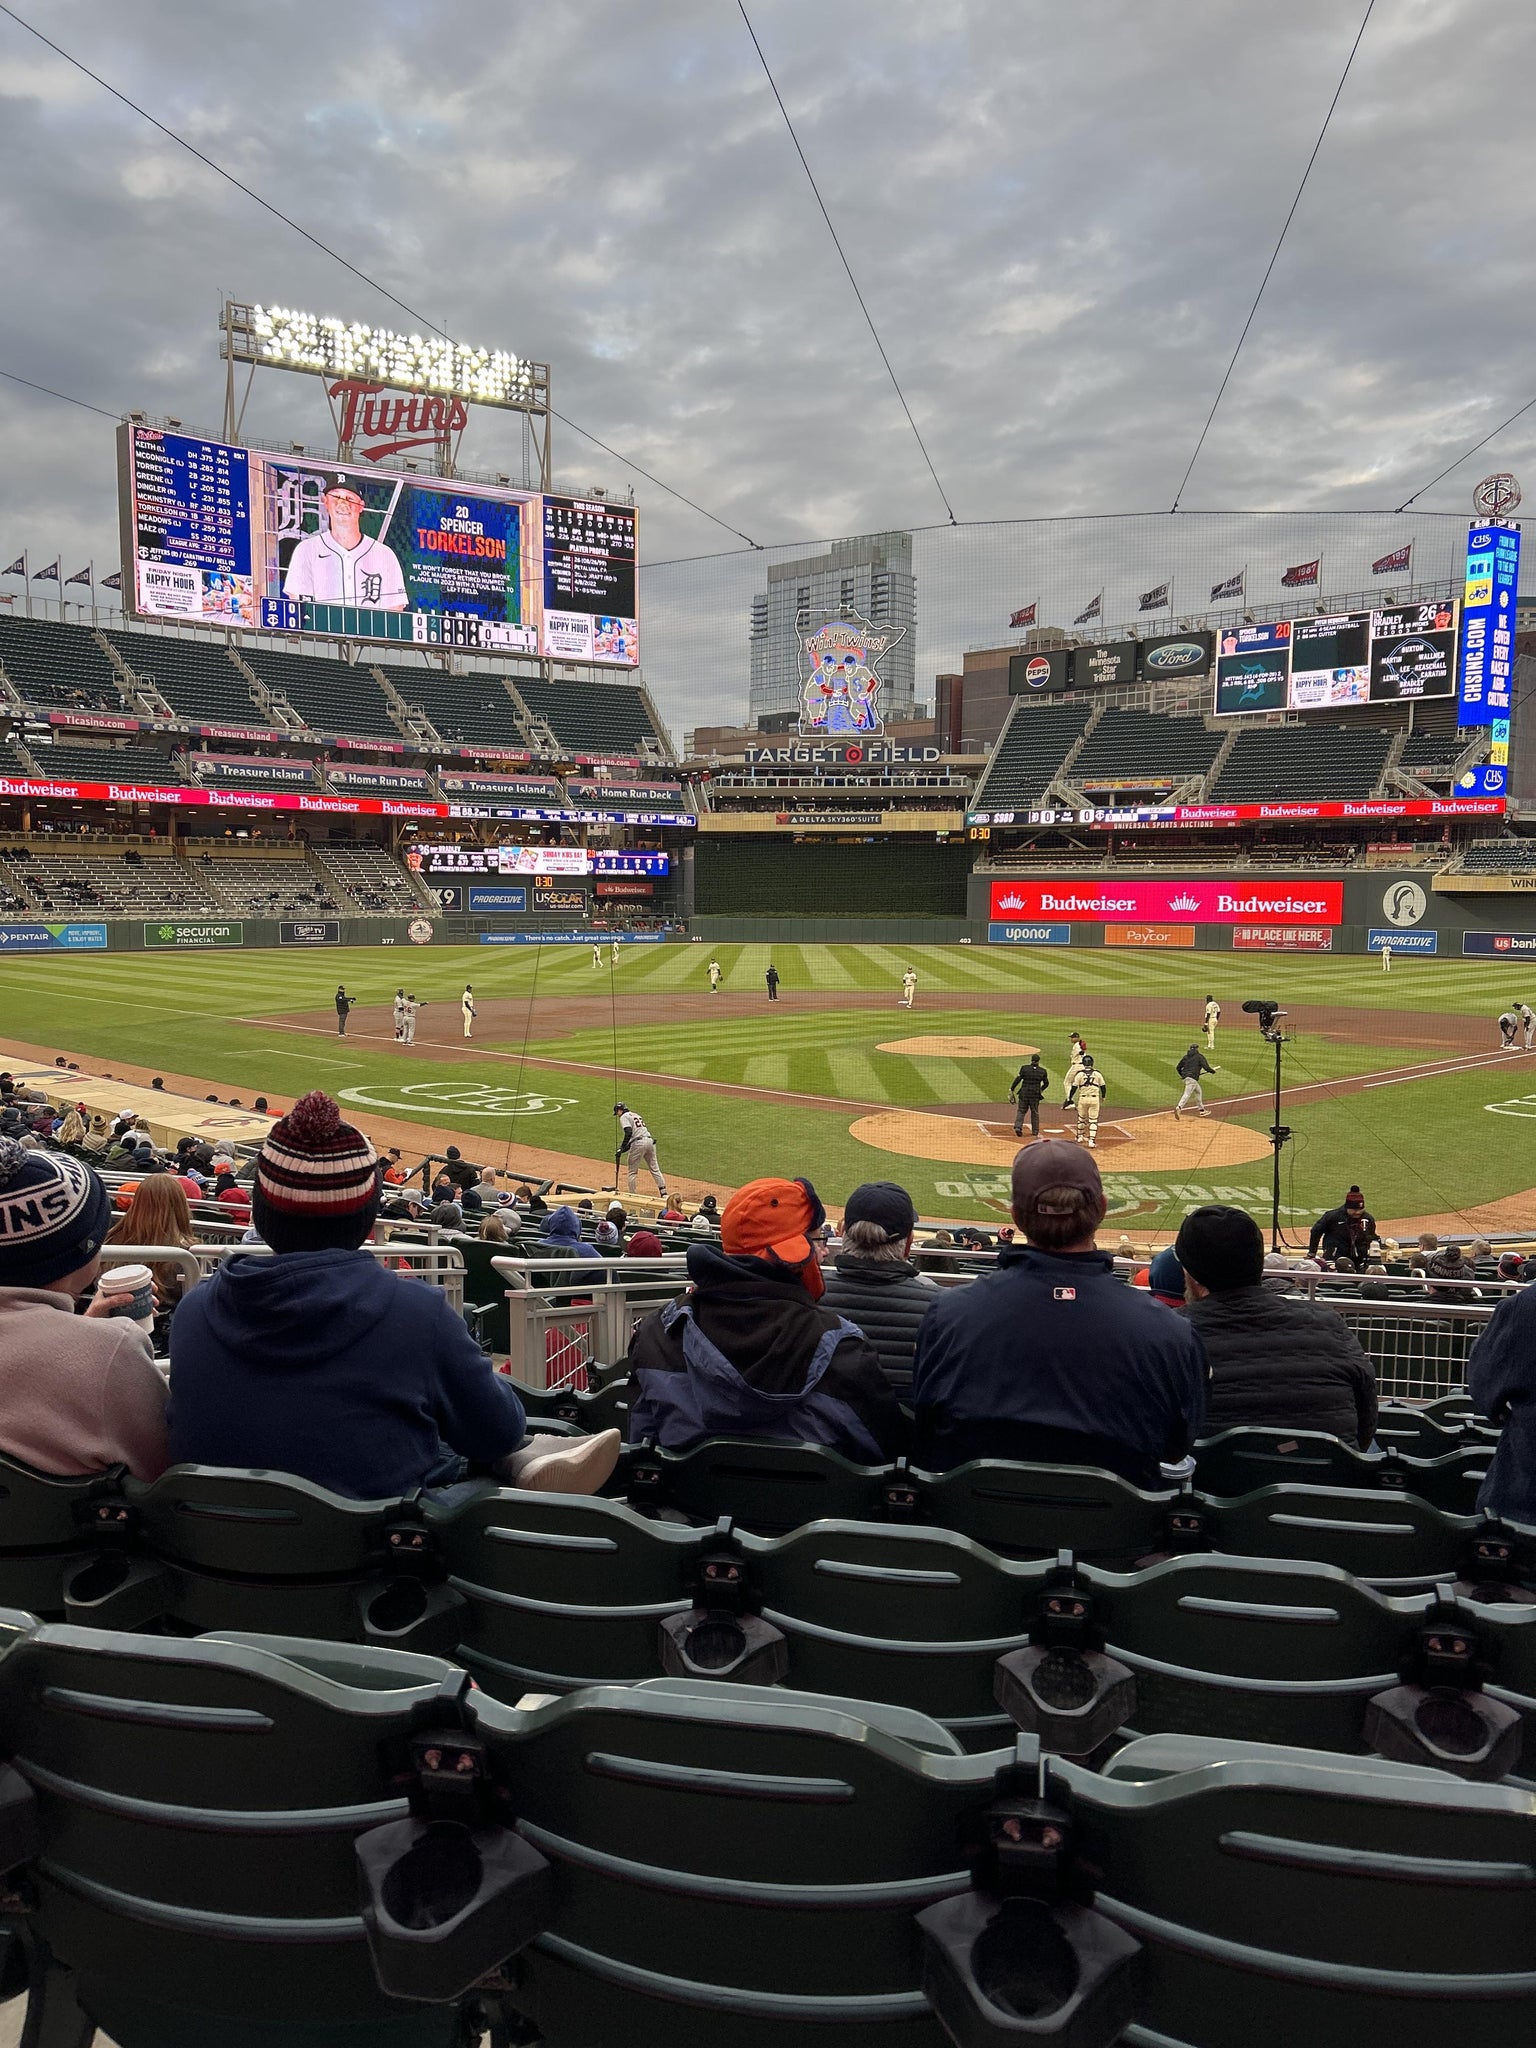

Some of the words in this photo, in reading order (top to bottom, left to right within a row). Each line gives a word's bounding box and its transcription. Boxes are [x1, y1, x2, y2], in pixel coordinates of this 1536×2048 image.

[329, 380, 467, 442] Twins
[136, 441, 156, 451] KEITH
[136, 450, 175, 465] MCGONIGLE
[136, 461, 163, 473] TORRES
[136, 472, 164, 483] GREENE
[200, 485, 214, 493] .205
[137, 482, 167, 494] DINGLER
[137, 492, 176, 506] MCKINSTRY
[201, 505, 215, 513] .300
[573, 502, 585, 510] THIS
[586, 504, 605, 513] SEASON
[138, 502, 178, 516] TORKELSON
[456, 505, 469, 518] 20
[138, 514, 172, 525] MEADOWS
[202, 524, 215, 533] .259
[139, 523, 157, 532] BÁEZ
[440, 517, 483, 535] SPENCER
[417, 528, 506, 559] TORKELSON
[442, 566, 464, 574] FORGET
[1298, 564, 1317, 576] 1987
[146, 573, 171, 587] HAPPY
[173, 577, 195, 590] HOUR
[409, 576, 432, 584] PLAQUE
[1419, 605, 1437, 621] 26
[431, 618, 436, 628] 2
[549, 621, 571, 631] HAPPY
[572, 623, 589, 633] HOUR
[1374, 615, 1403, 627] BRADLEY
[485, 629, 491, 639] 0
[1275, 624, 1290, 638] 20
[806, 633, 838, 652] Win!
[840, 633, 886, 650] Twins!
[1402, 644, 1424, 653] BUXTON
[1097, 650, 1107, 658] The
[1158, 648, 1192, 666] Ford
[1464, 618, 1486, 702] CHSINC.COM
[1089, 656, 1120, 667] Minnesota
[1094, 673, 1116, 682] Tribune
[210, 728, 245, 739] Treasure
[246, 732, 270, 741] Island
[468, 750, 504, 759] Treasure
[744, 747, 842, 762] TARGET
[868, 747, 941, 762] FIELD
[221, 765, 269, 777] Treasure
[272, 769, 304, 780] Island
[349, 774, 376, 784] Home
[380, 777, 398, 786] Run
[400, 778, 423, 788] Deck
[0, 779, 78, 796] Budweiser
[470, 782, 513, 792] Treasure
[516, 784, 546, 794] Island
[109, 786, 181, 802] Budweiser
[208, 791, 274, 807] Budweiser
[601, 789, 627, 798] Home
[630, 790, 647, 798] Run
[650, 791, 672, 799] Deck
[300, 796, 360, 811] Budweiser
[382, 802, 437, 816] Budweiser
[1343, 804, 1406, 815] Budweiser
[1432, 801, 1498, 813] Budweiser
[1181, 808, 1237, 818] Budweiser
[1260, 806, 1319, 816] Budweiser
[1114, 821, 1149, 830] UNIVERSAL
[970, 828, 990, 839] 0:30
[588, 850, 595, 858] 29
[535, 877, 552, 887] 0:30
[472, 895, 522, 903] PROGRESSIVE
[1040, 894, 1132, 911] Budweiser
[1217, 896, 1323, 914] Budweiser
[176, 926, 230, 937] securian
[1006, 928, 1051, 940] uponor
[1127, 930, 1171, 943] Paycor
[1252, 930, 1281, 941] PLACE
[1283, 930, 1296, 941] LIKE
[1298, 931, 1322, 942] HERE
[1372, 935, 1433, 947] PROGRESSIVE
[400, 1082, 580, 1112] CHS
[934, 1182, 1169, 1200] OPNG
[1164, 1184, 1275, 1200] DAY
